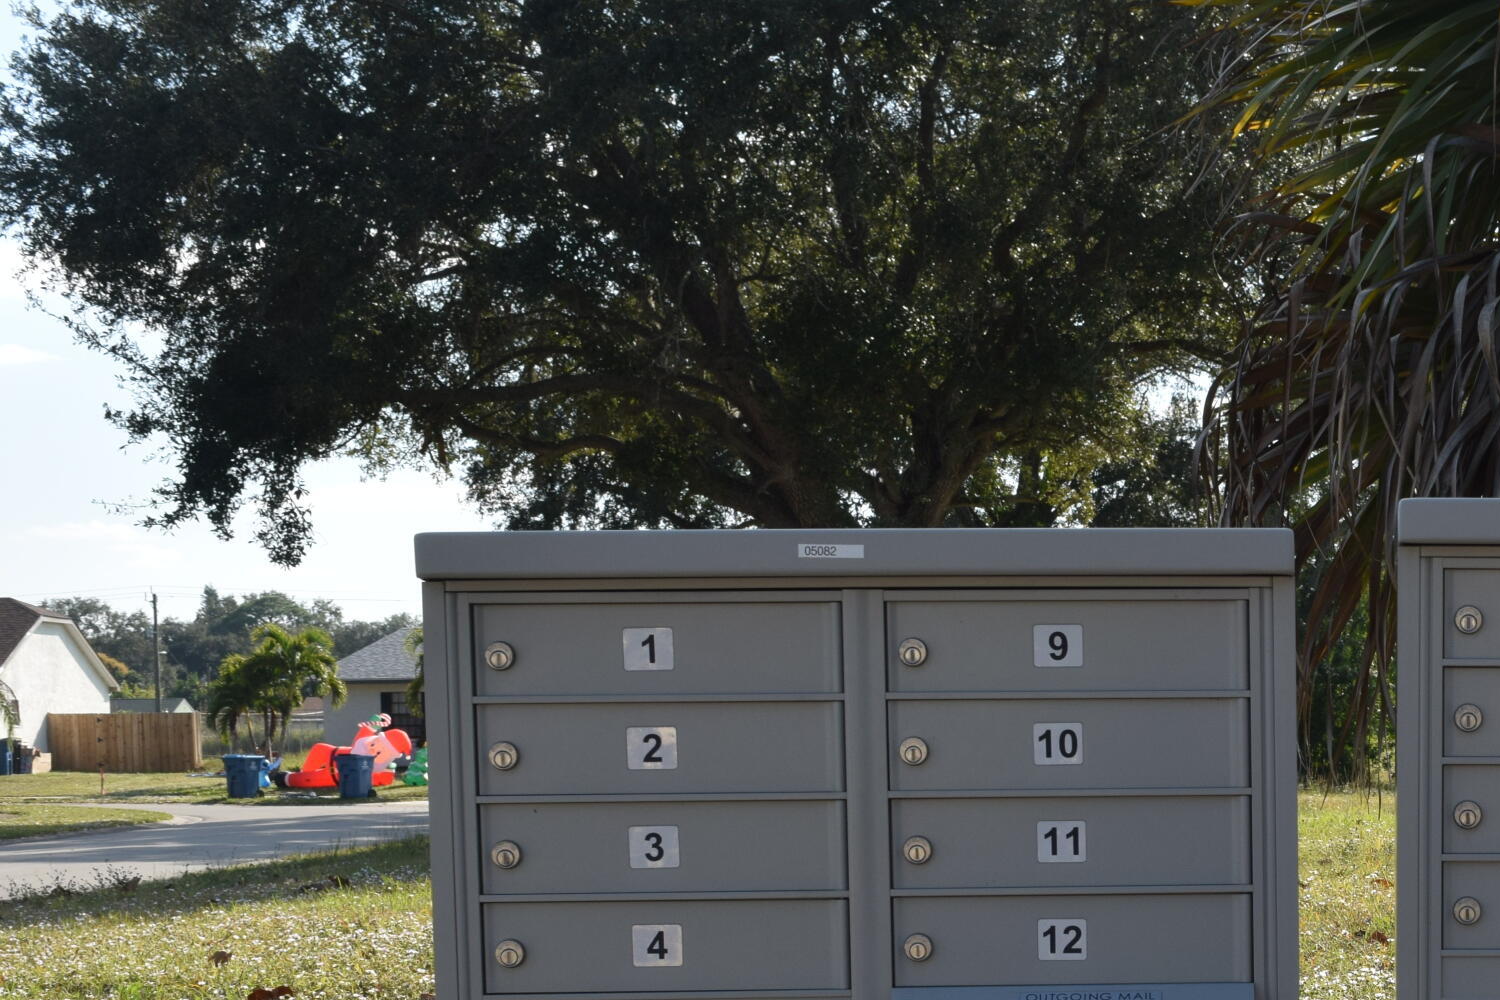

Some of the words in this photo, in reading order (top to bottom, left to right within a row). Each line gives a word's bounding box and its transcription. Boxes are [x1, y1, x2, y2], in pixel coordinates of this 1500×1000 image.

[804, 545, 837, 557] 05082
[641, 634, 656, 664] 1
[1048, 631, 1069, 661] 9
[642, 733, 663, 763] 2
[1038, 729, 1078, 759] 10
[644, 832, 665, 862] 3
[1044, 826, 1080, 856] 11
[646, 930, 669, 960] 4
[1042, 925, 1083, 954] 12
[1118, 992, 1154, 1000] MAIL
